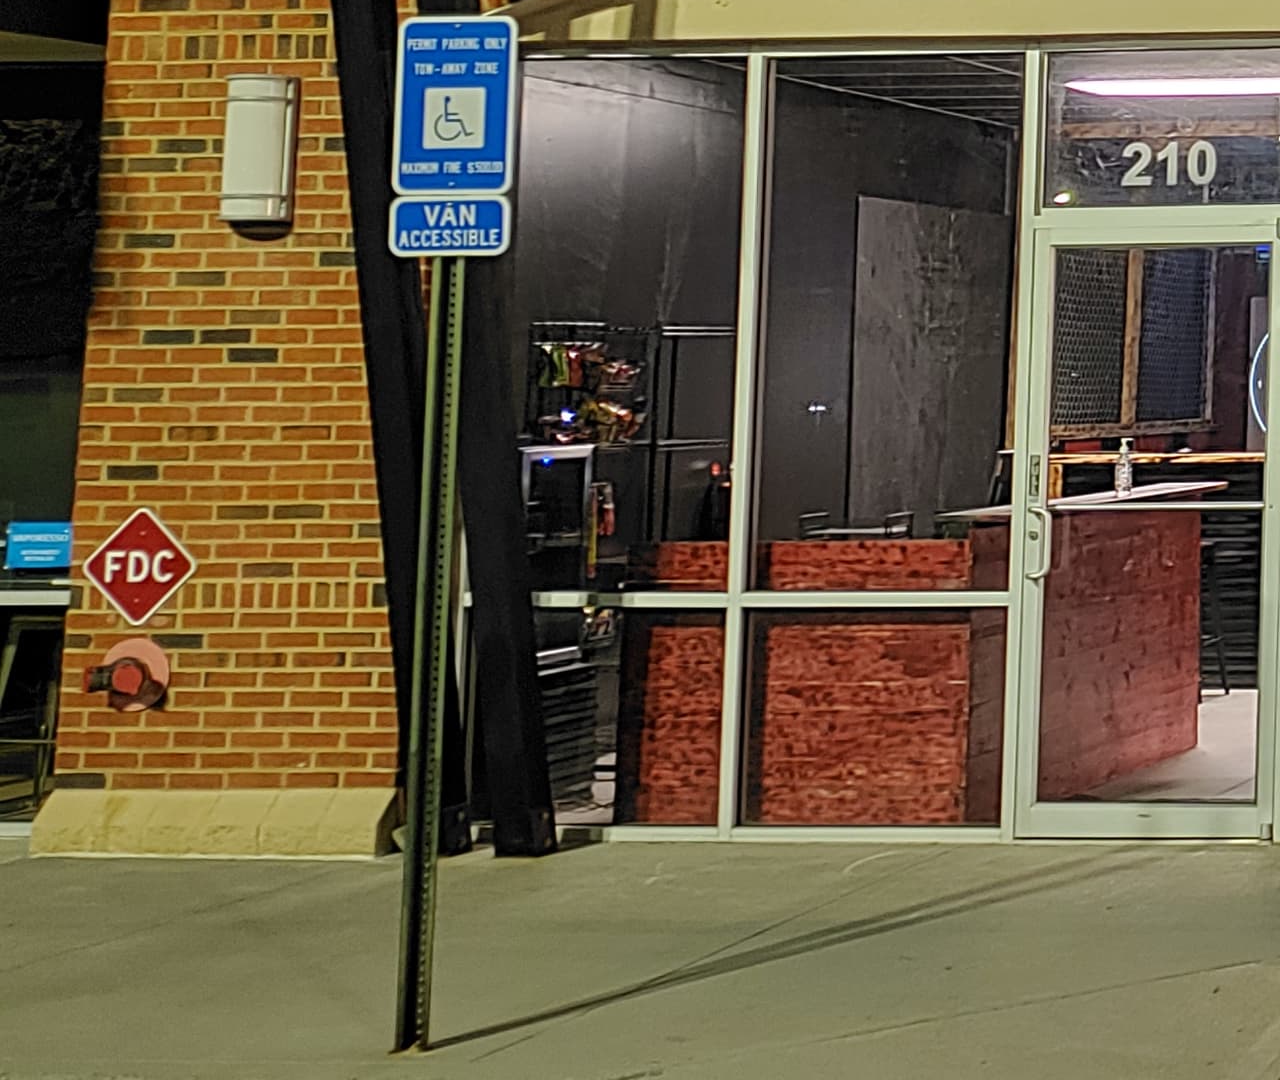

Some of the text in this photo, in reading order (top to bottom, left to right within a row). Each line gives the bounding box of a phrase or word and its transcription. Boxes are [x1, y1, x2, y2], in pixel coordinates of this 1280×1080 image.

[1121, 140, 1218, 187] 210
[423, 204, 477, 227] VAN
[399, 229, 501, 248] ACCESSIBLE
[104, 549, 175, 584] FDC
